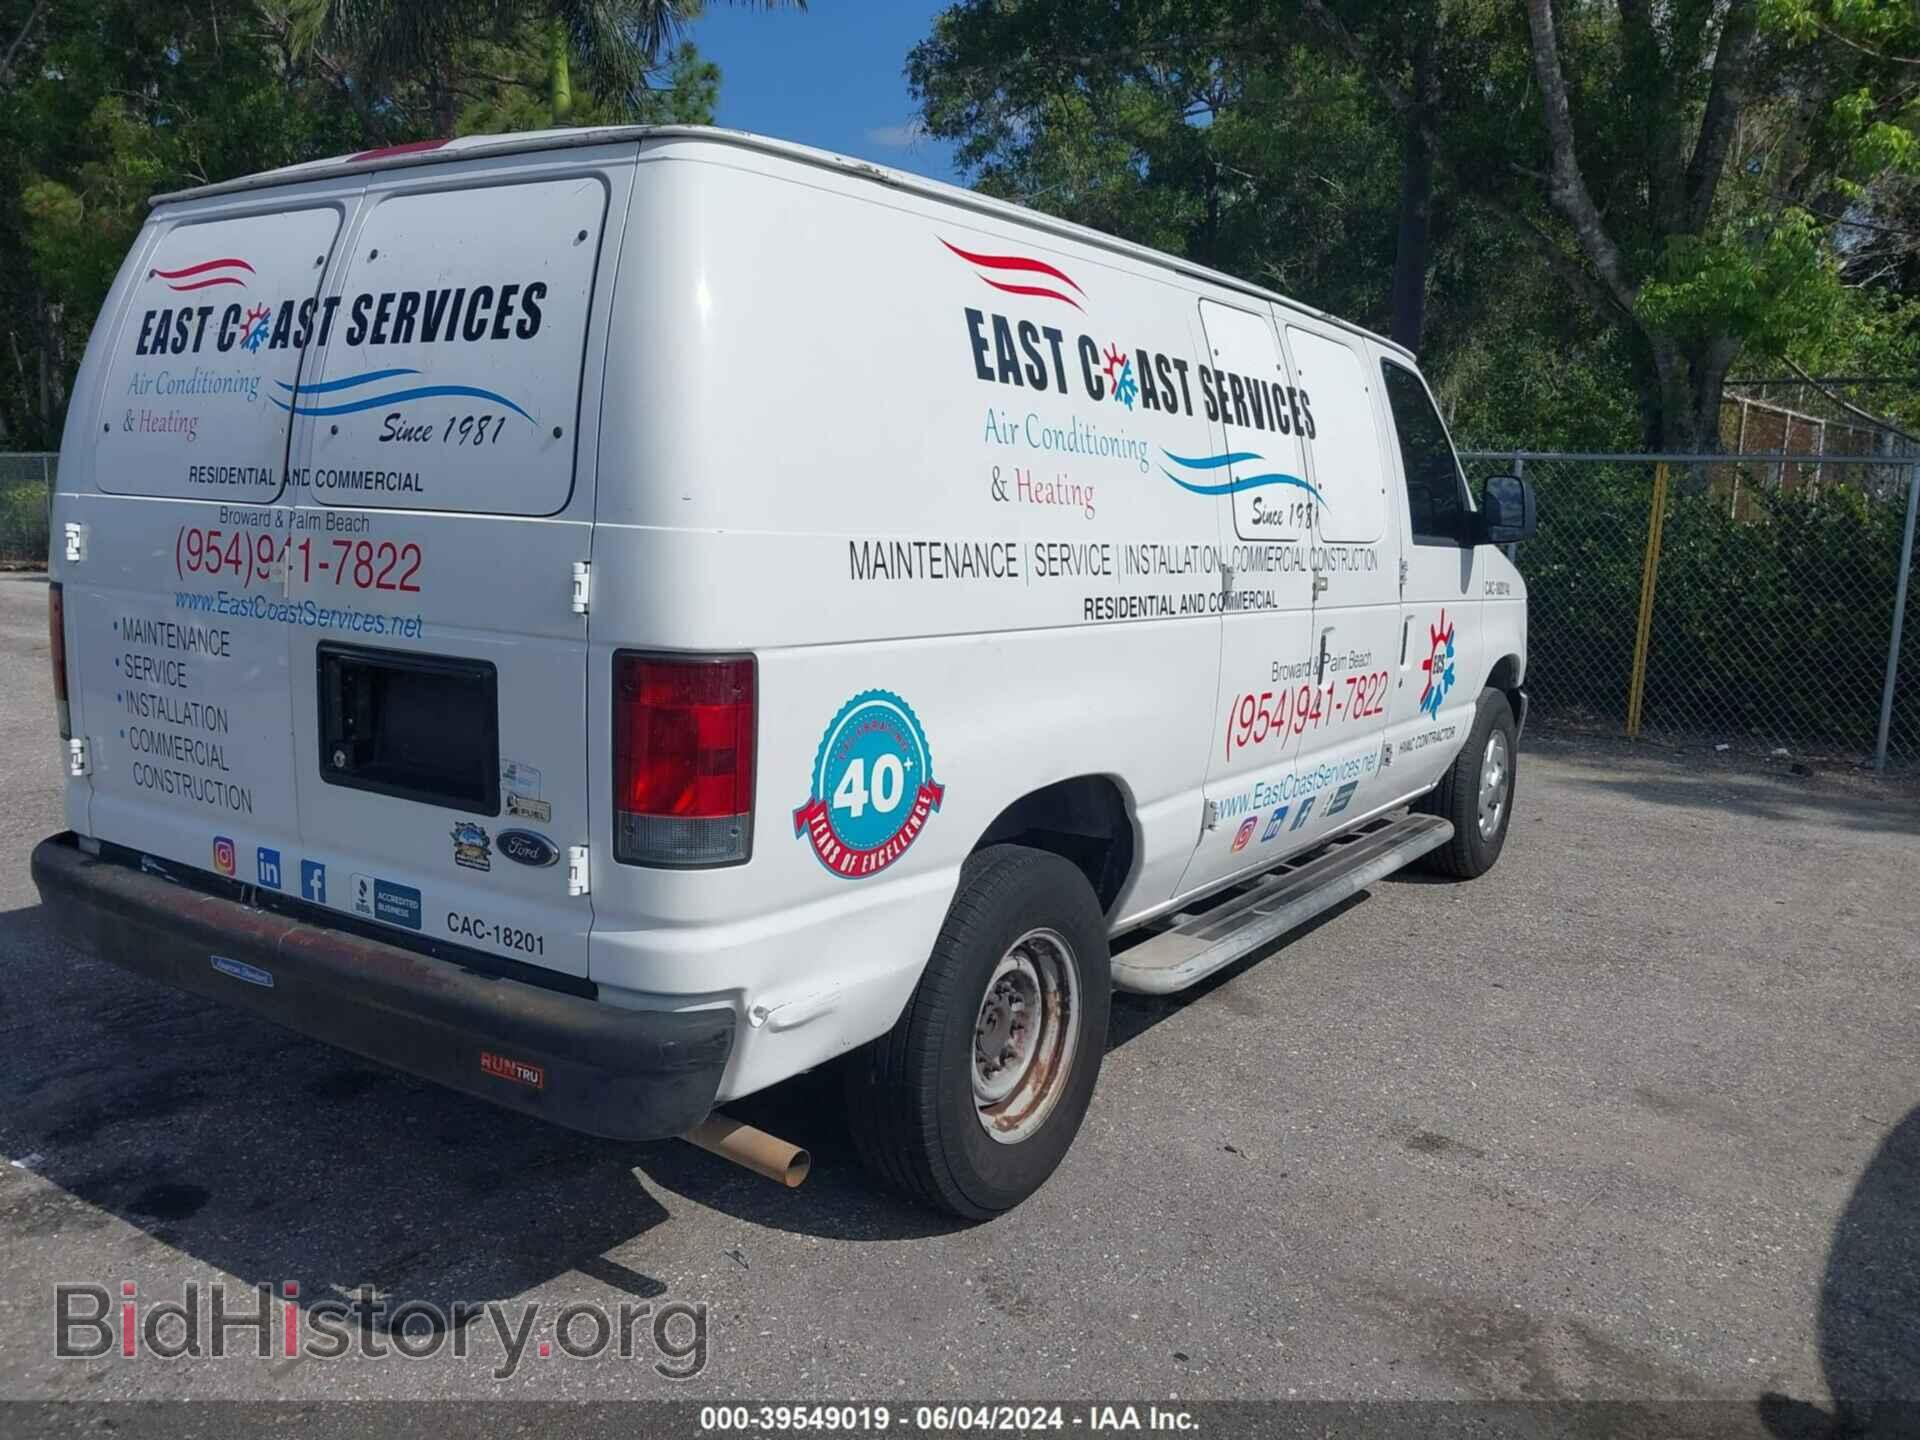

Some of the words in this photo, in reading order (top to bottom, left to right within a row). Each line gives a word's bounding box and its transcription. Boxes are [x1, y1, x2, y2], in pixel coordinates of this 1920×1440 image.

[136, 306, 214, 355] EAST
[346, 281, 547, 346] SERVICES
[127, 371, 153, 395] Air
[156, 366, 261, 401] Conditioning
[963, 306, 1069, 394] EAST
[1198, 364, 1315, 440] SERVICES
[123, 409, 135, 432] &
[138, 409, 200, 441] Heating
[379, 412, 433, 444] Since
[441, 415, 506, 447] 1981
[984, 408, 1019, 447] Air
[1025, 415, 1150, 473] Conditioning
[188, 466, 277, 487] RESIDENTIAL
[284, 468, 311, 488] AND
[315, 469, 424, 492] COMMERCIAL
[990, 466, 1009, 502] &
[1016, 468, 1095, 519] Heating
[219, 505, 271, 528] Broward
[275, 510, 284, 529] &
[289, 511, 321, 531] Palm
[326, 512, 370, 533] Beach
[1251, 496, 1284, 526] Since
[1289, 502, 1319, 530] 1981
[849, 541, 1019, 581] MAINTENANCE
[1034, 544, 1112, 577] SERVICE
[1125, 544, 1222, 575] INSTALLATION
[1232, 545, 1306, 573] COMMERCIAL
[1309, 547, 1379, 573] CONSTRUCTION
[174, 590, 423, 639] www.EastCoastServices.net
[1084, 596, 1177, 621] RESIDENTIAL
[1180, 595, 1206, 615] AND
[1209, 589, 1279, 613] COMMERCIAL
[122, 616, 231, 657] MAINTENANCE
[124, 653, 188, 688] SERVICE
[1272, 652, 1311, 682] Broward
[1322, 652, 1346, 672] Palm
[1349, 649, 1372, 670] Beach
[126, 690, 228, 734] INSTALLATION
[1226, 671, 1389, 763] (954)941-7822
[129, 726, 230, 772] COMMERCIAL
[132, 761, 253, 815] CONSTRUCTION
[832, 752, 914, 818] 40+
[508, 837, 539, 860] Ford
[811, 811, 840, 863] YEARS
[840, 851, 857, 873] OF
[861, 793, 931, 873] EXCELLENCE
[447, 911, 545, 956] CAC-18201
